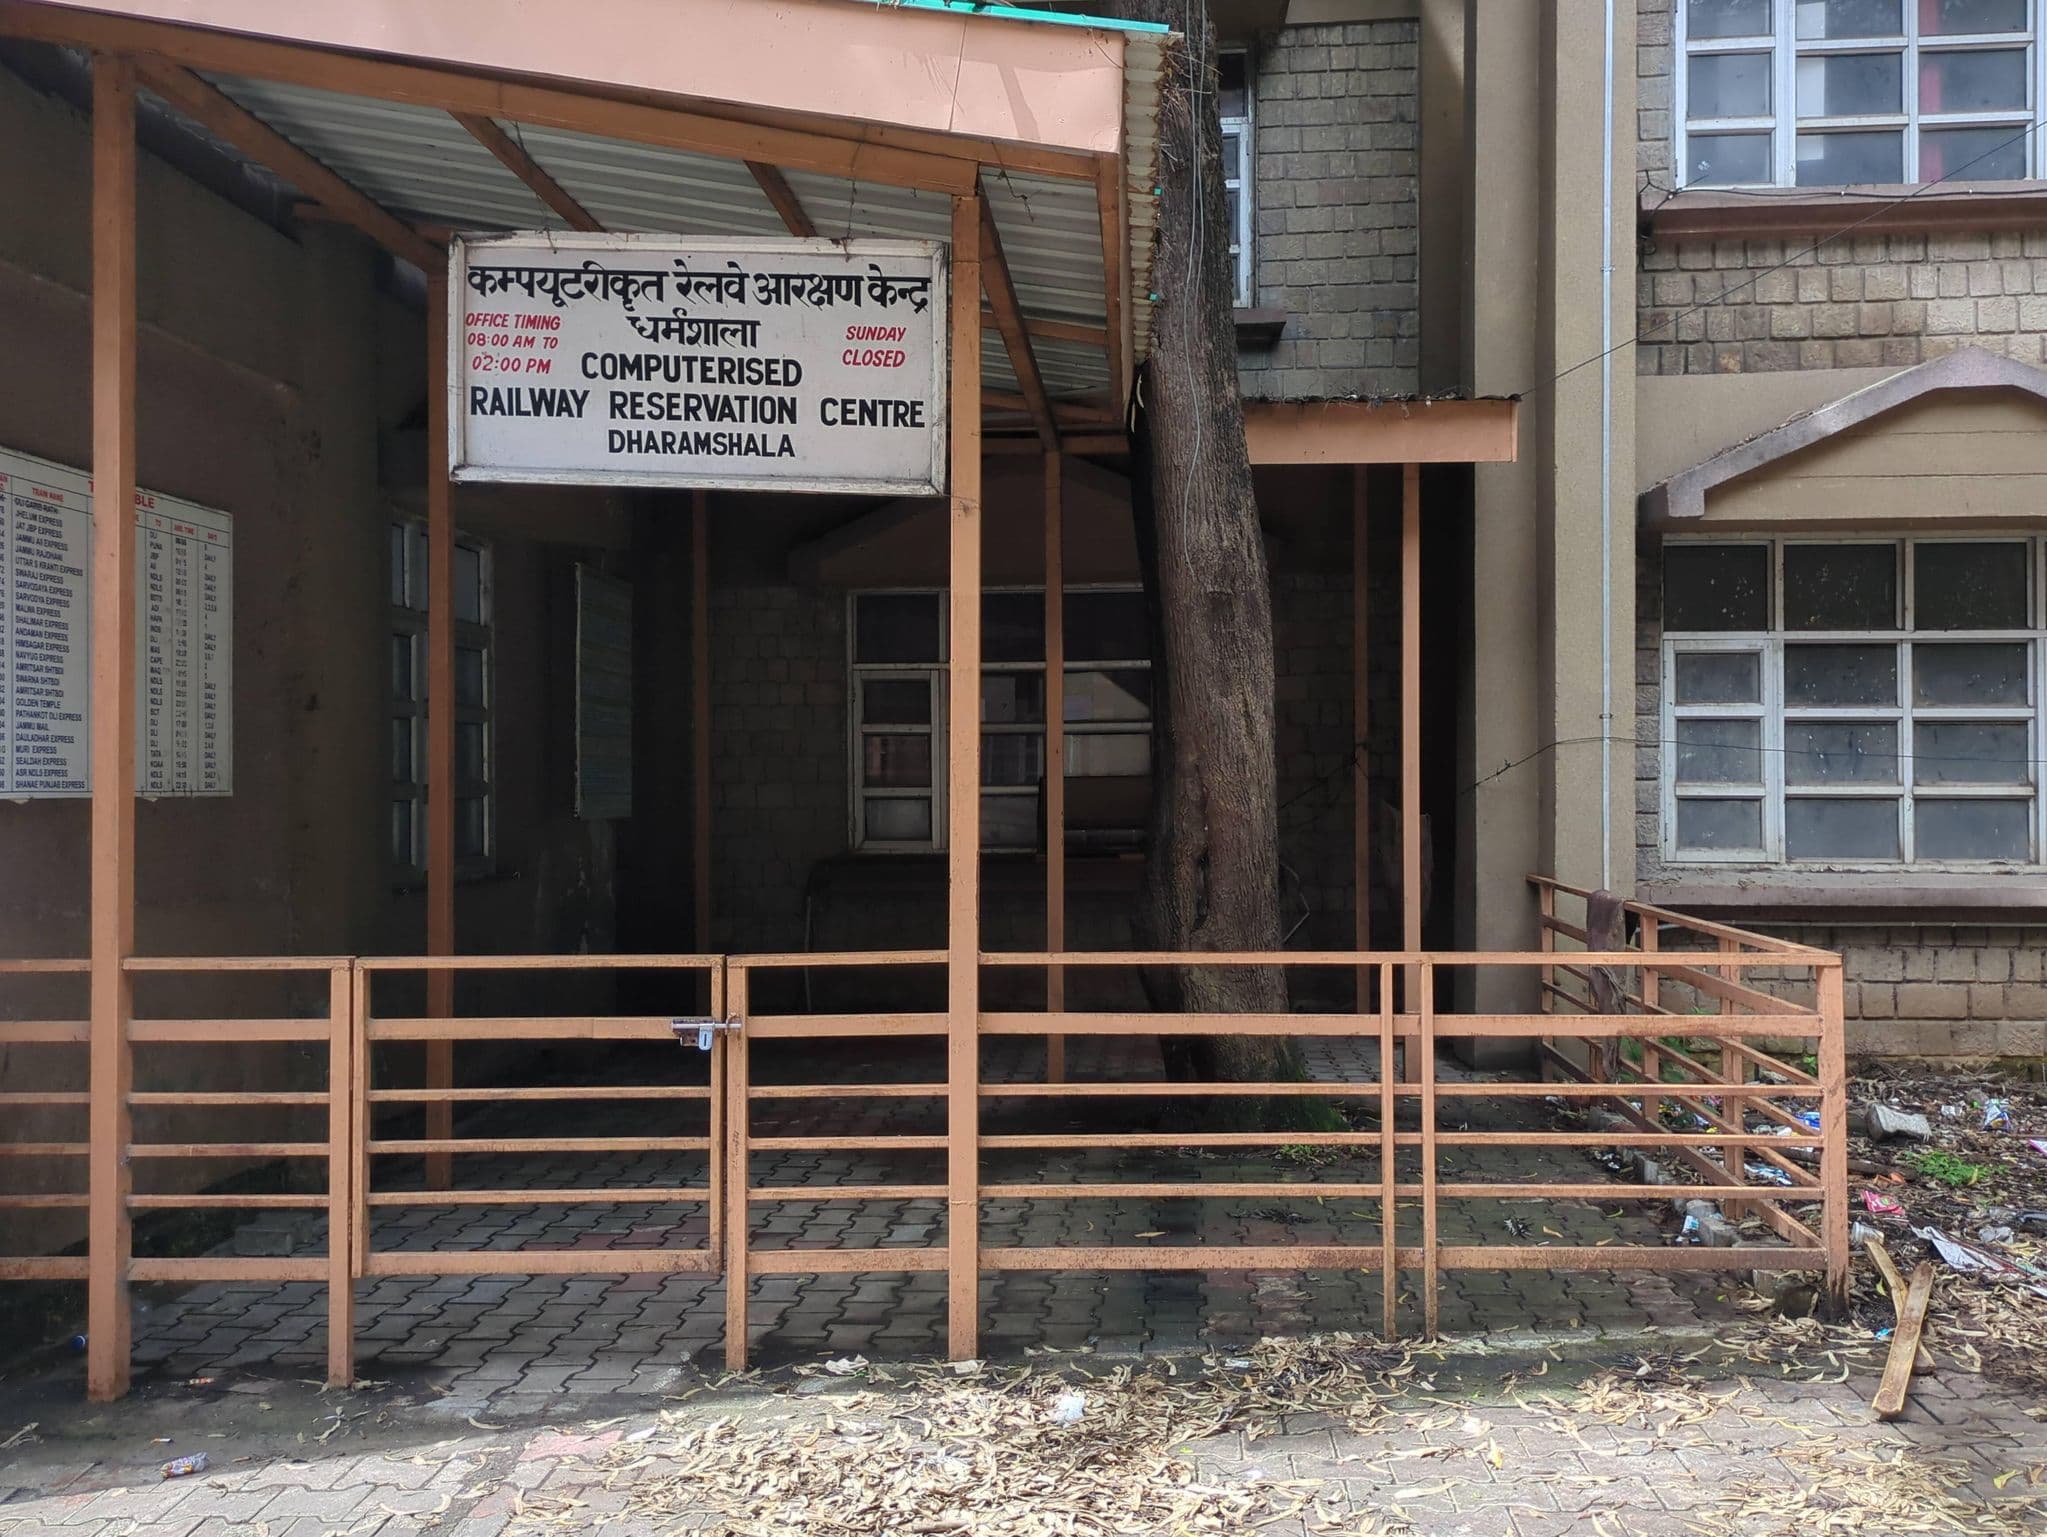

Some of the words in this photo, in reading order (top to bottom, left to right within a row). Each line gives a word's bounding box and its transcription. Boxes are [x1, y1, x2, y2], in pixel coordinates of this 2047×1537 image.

[672, 258, 750, 304] रेलवे
[752, 272, 864, 309] आरक्षण
[866, 263, 933, 313] केन्द्र
[466, 313, 509, 328] OFFICE
[514, 314, 561, 331] TIMING
[625, 307, 761, 348] धर्मशाला
[467, 333, 509, 347] 08:00
[512, 335, 536, 349] AM
[543, 336, 559, 349] TO
[846, 326, 907, 342] SUNDAY
[472, 355, 521, 372] 02:00
[526, 358, 552, 374] PM
[581, 352, 802, 387] COMPUTERISED
[842, 349, 905, 368] CLOSED
[470, 386, 590, 418] RAILWAY
[609, 391, 797, 425] RESERVATION
[820, 398, 926, 428] CENTRE
[608, 430, 796, 458] DHARAMSHALA
